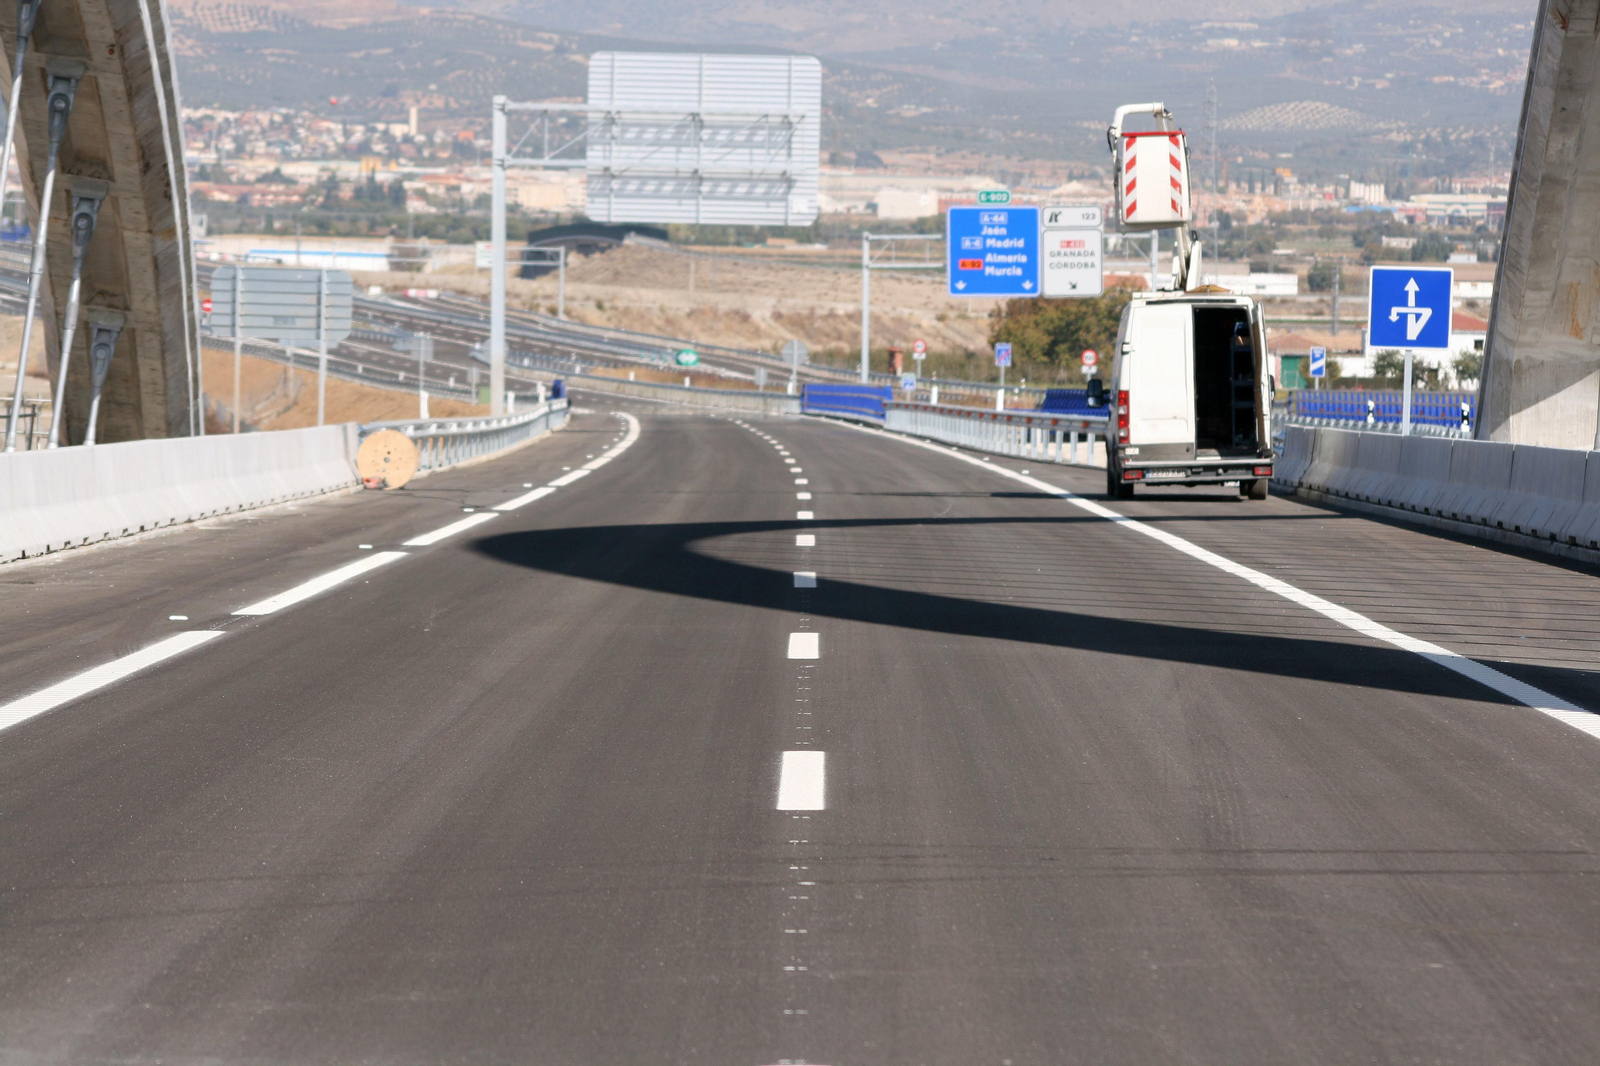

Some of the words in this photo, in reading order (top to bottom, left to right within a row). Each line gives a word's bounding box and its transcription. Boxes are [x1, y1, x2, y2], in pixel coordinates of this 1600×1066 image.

[983, 214, 1006, 222] A-44
[1081, 213, 1096, 221] 123
[981, 225, 1007, 236] Jaén
[965, 239, 981, 247] A-4
[985, 238, 1025, 249] Madrid
[1049, 250, 1096, 258] GRANADA
[984, 265, 1023, 276] Murcia
